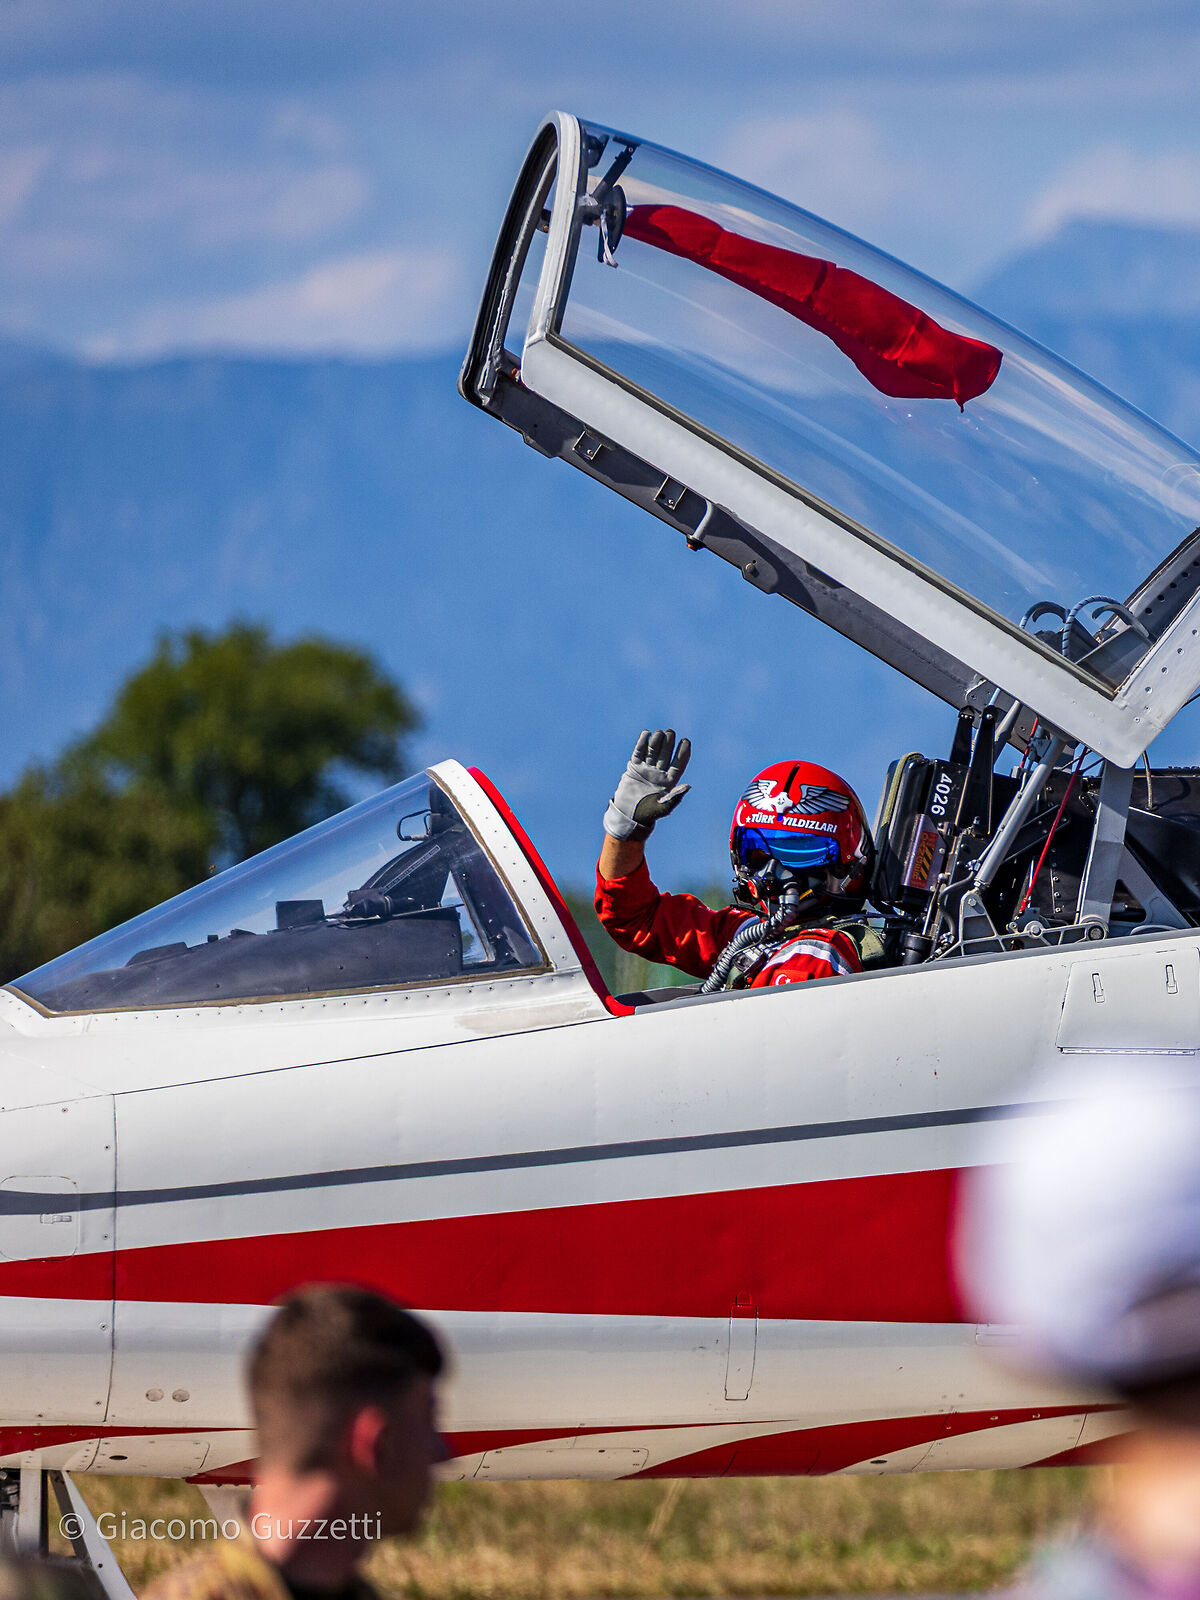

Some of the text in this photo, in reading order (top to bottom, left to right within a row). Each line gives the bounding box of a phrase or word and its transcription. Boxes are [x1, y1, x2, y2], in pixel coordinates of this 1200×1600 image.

[931, 772, 952, 816] 4026
[751, 812, 837, 833] TÜRK YILDIZLARI
